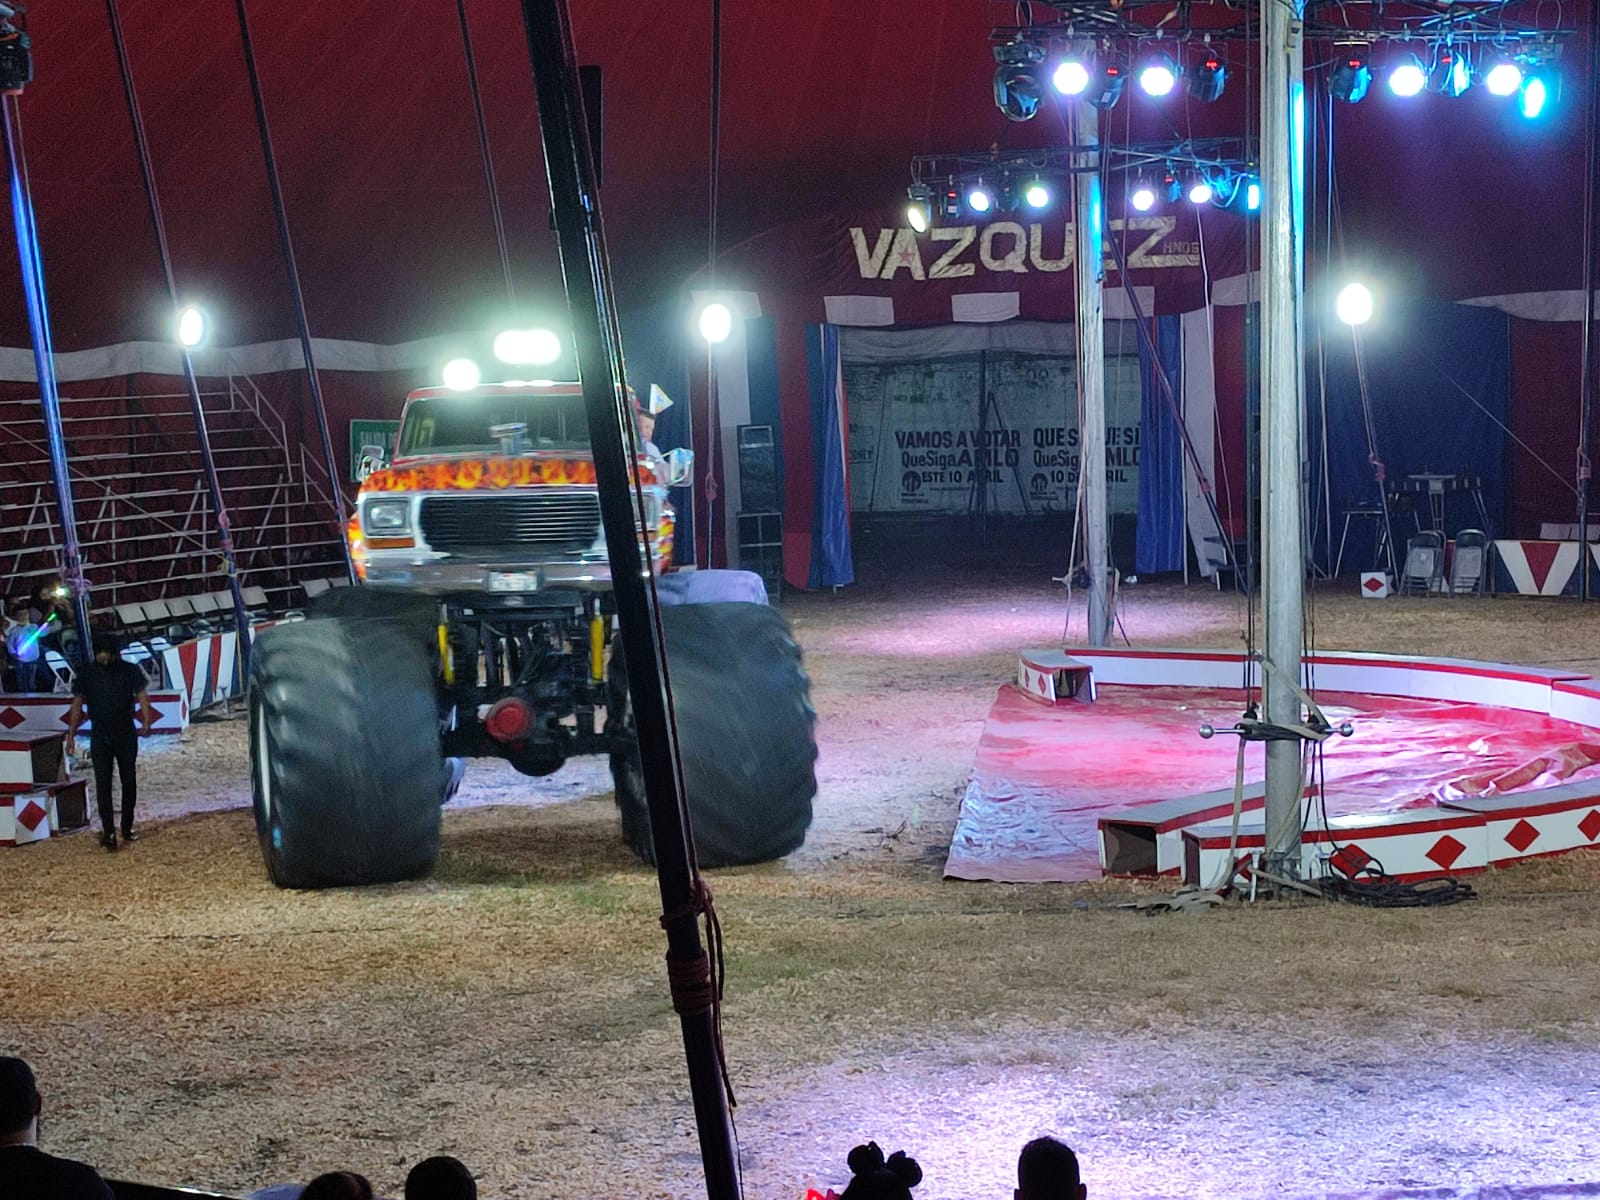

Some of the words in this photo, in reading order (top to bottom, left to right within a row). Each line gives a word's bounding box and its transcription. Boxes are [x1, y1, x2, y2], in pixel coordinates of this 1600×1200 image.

[894, 431, 952, 448] VAMOS
[956, 431, 967, 448] A
[1033, 427, 1065, 448] QUE
[922, 471, 945, 483] ESTE
[949, 470, 962, 483] 10
[1051, 470, 1064, 483] 10
